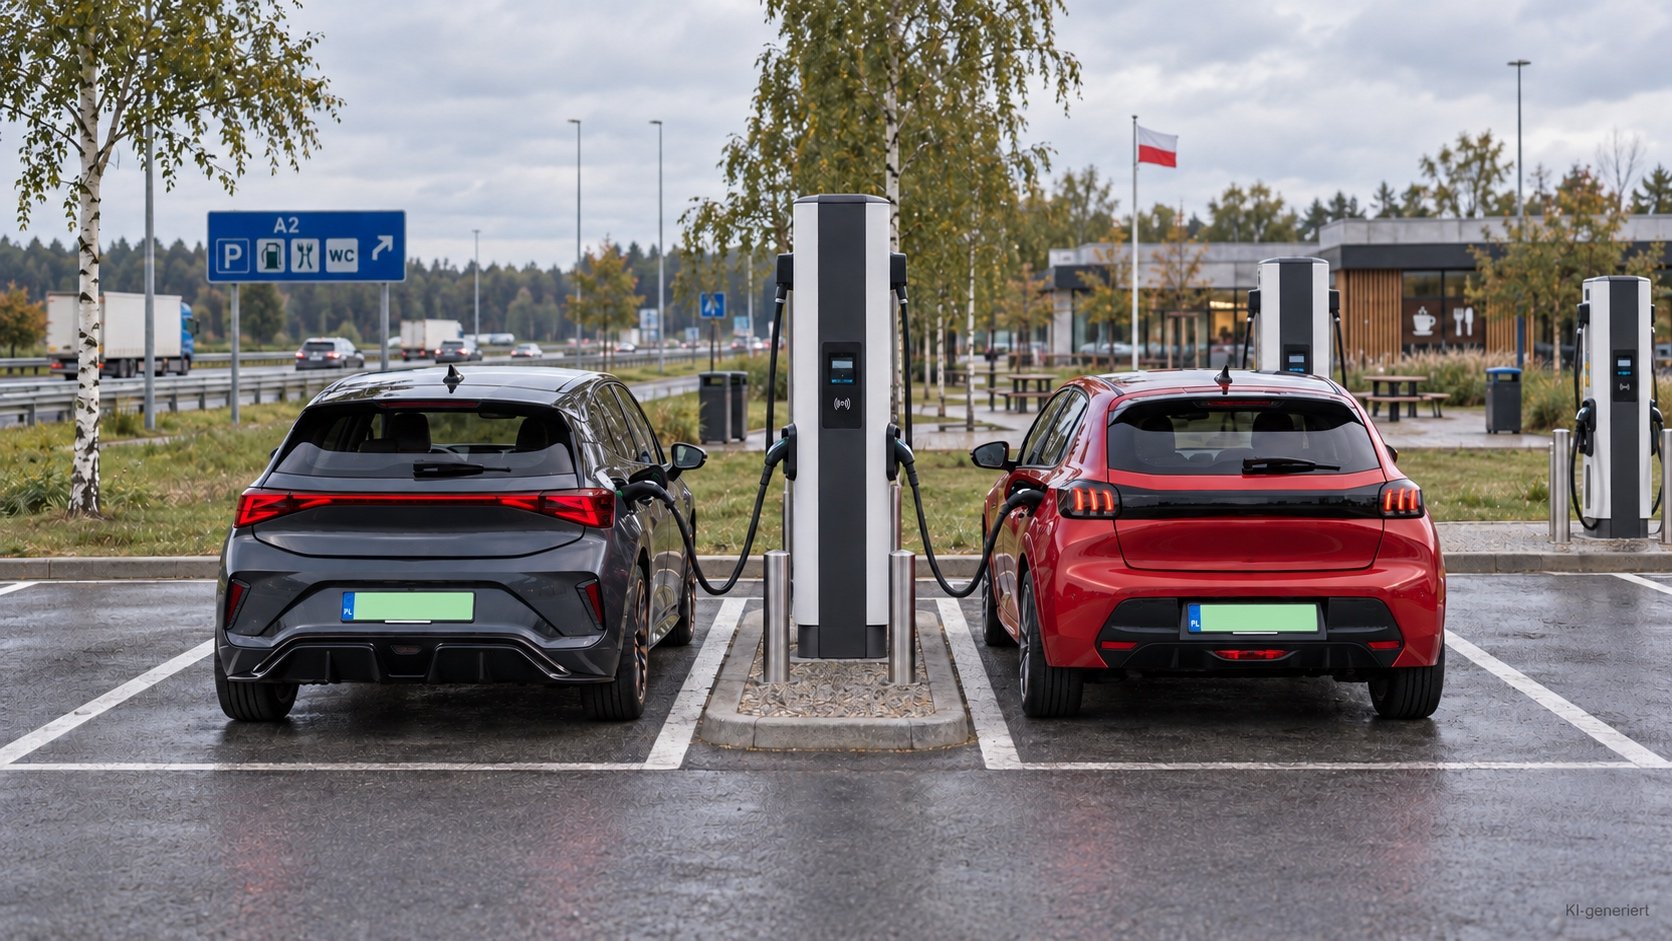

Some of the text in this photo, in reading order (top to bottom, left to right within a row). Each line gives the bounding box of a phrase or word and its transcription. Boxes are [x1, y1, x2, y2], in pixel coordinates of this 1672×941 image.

[273, 216, 300, 234] A2
[224, 243, 355, 269] P WC
[1190, 619, 1200, 627] PL
